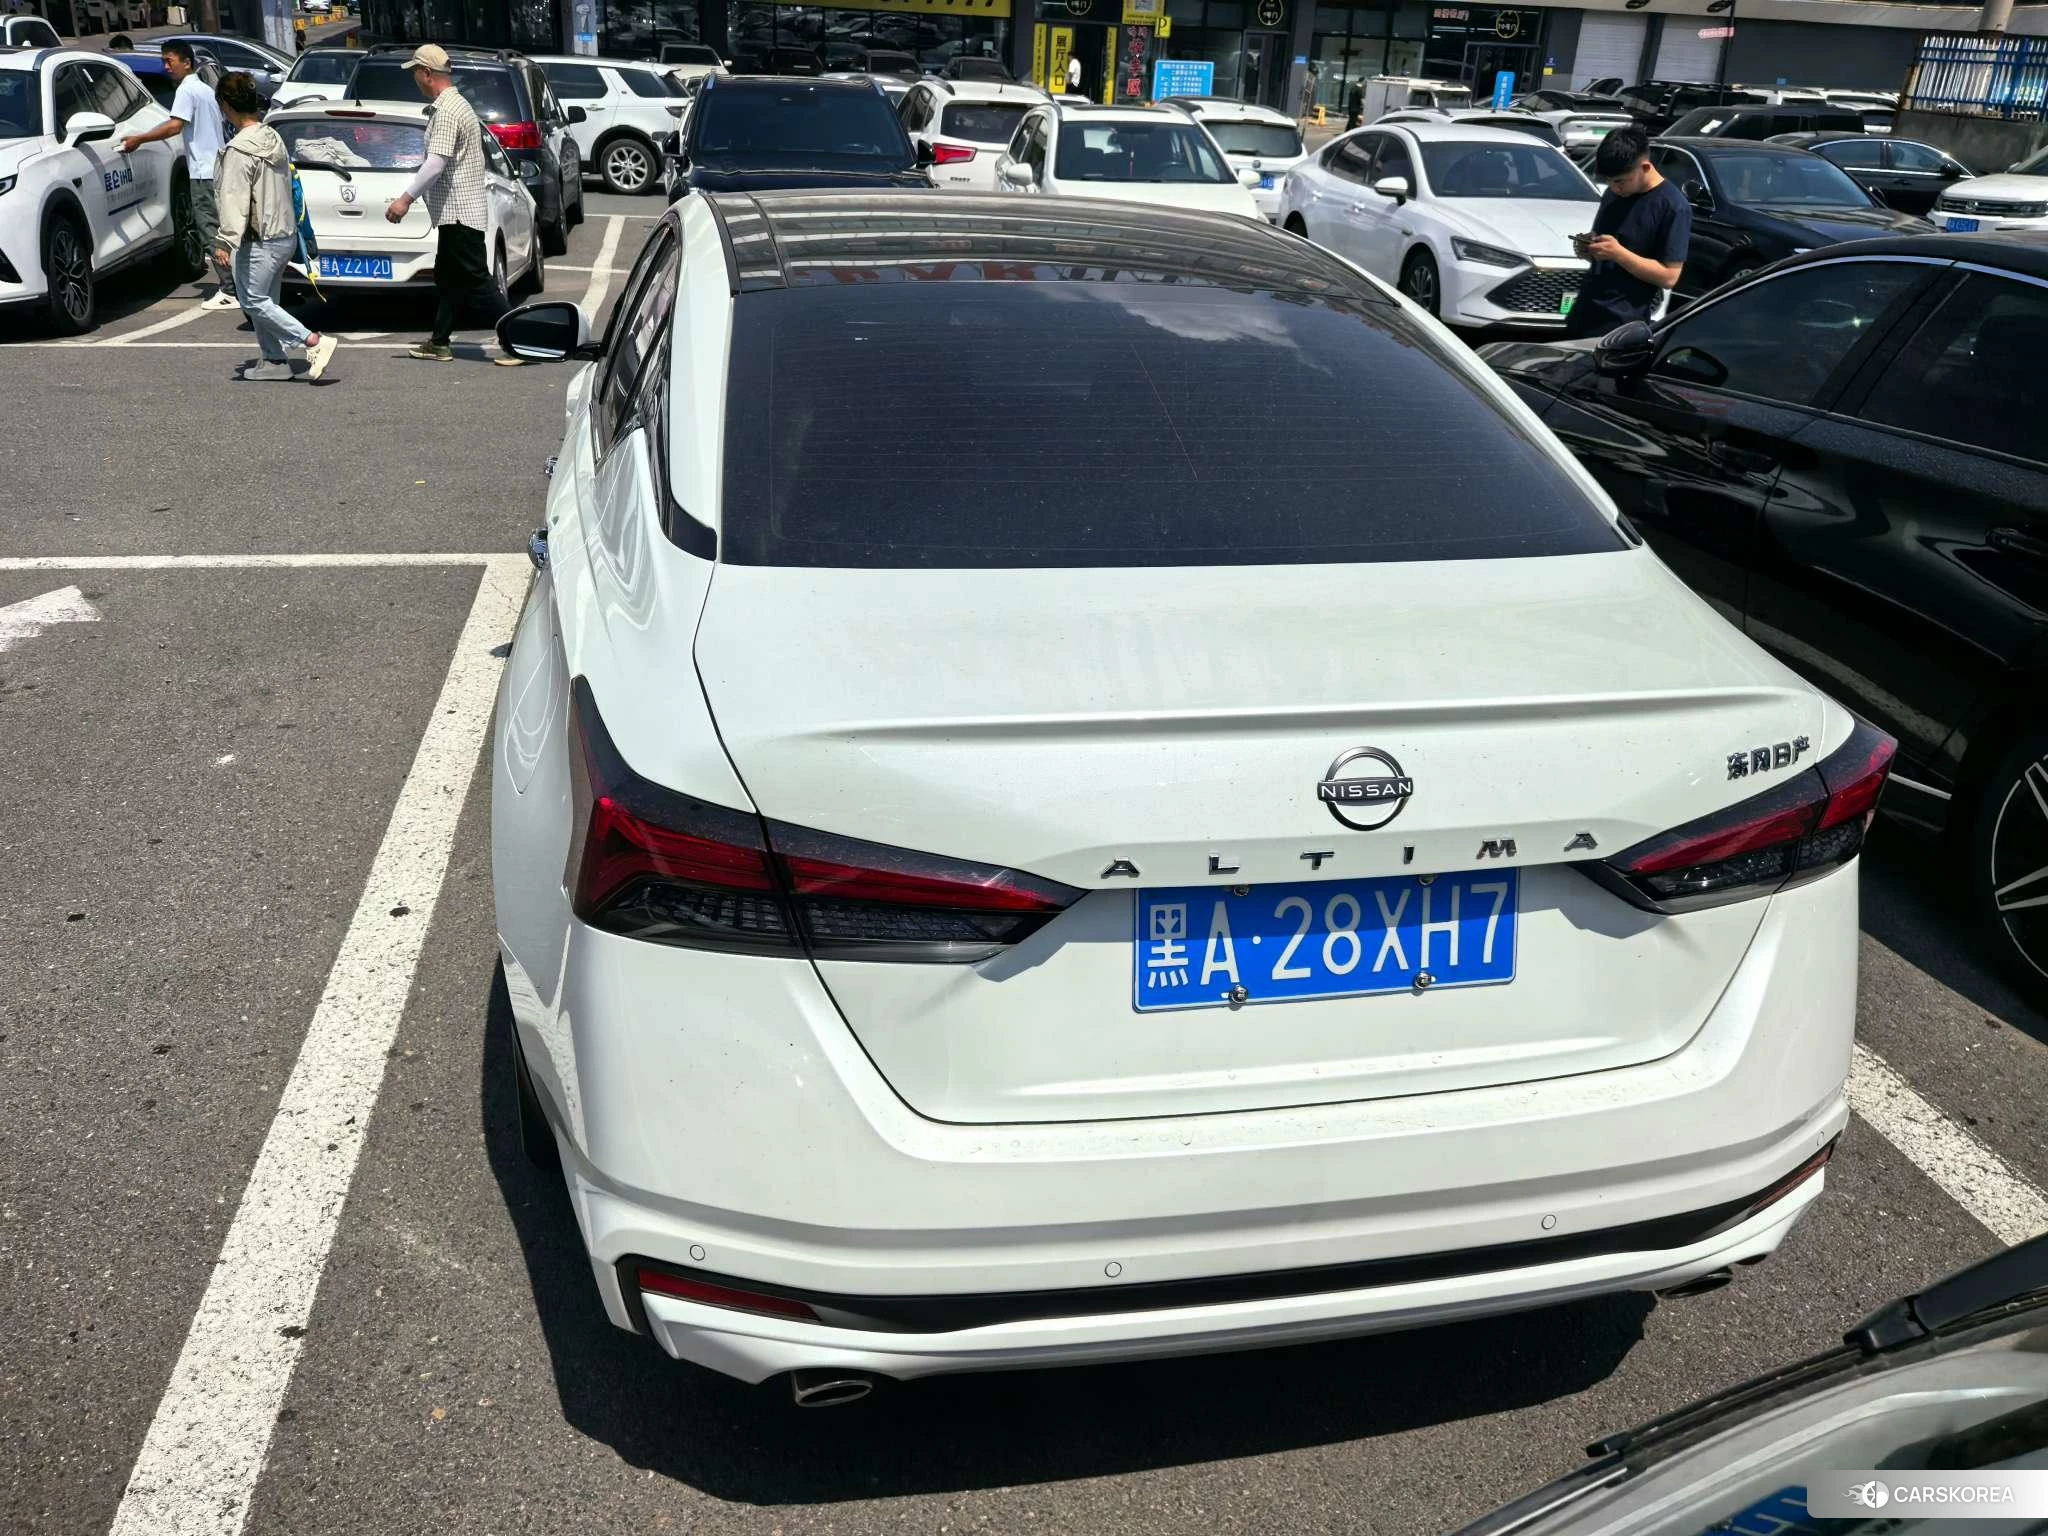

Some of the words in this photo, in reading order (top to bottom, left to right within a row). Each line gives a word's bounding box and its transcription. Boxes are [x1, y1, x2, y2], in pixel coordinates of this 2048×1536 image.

[1054, 35, 1067, 87] 展厅入口
[1727, 735, 1810, 781] 东风日产
[1320, 781, 1412, 798] NISSAN
